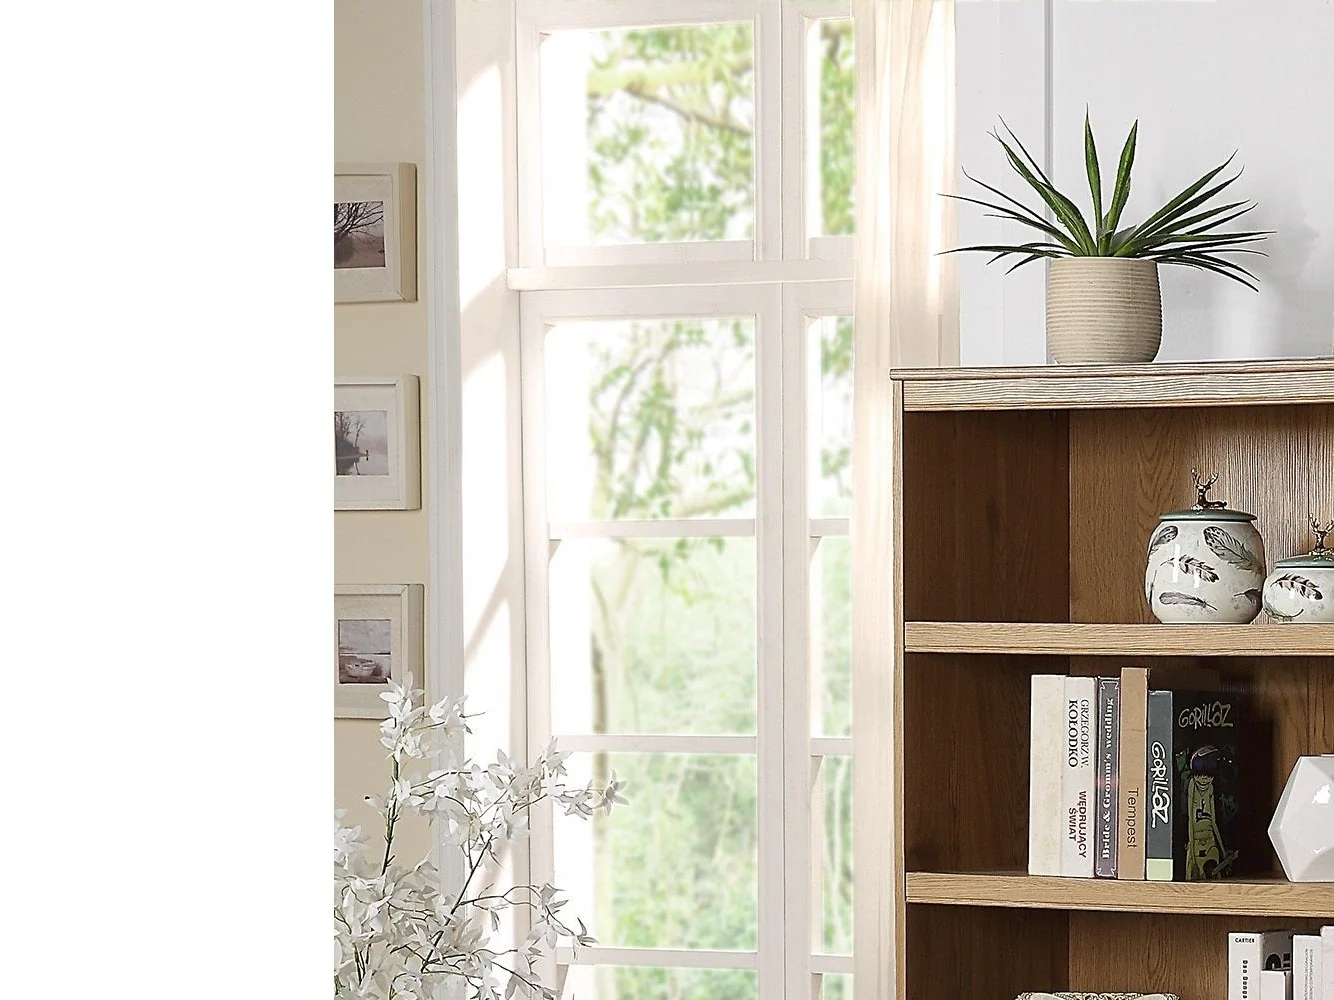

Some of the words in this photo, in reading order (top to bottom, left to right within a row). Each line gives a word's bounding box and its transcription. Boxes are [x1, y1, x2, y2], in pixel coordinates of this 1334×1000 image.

[1068, 700, 1078, 768] KOŁODKO
[1080, 699, 1090, 755] GRZEGORZ
[1103, 698, 1114, 749] wedding
[1102, 824, 1111, 859] Bride
[1125, 787, 1139, 849] Tempest
